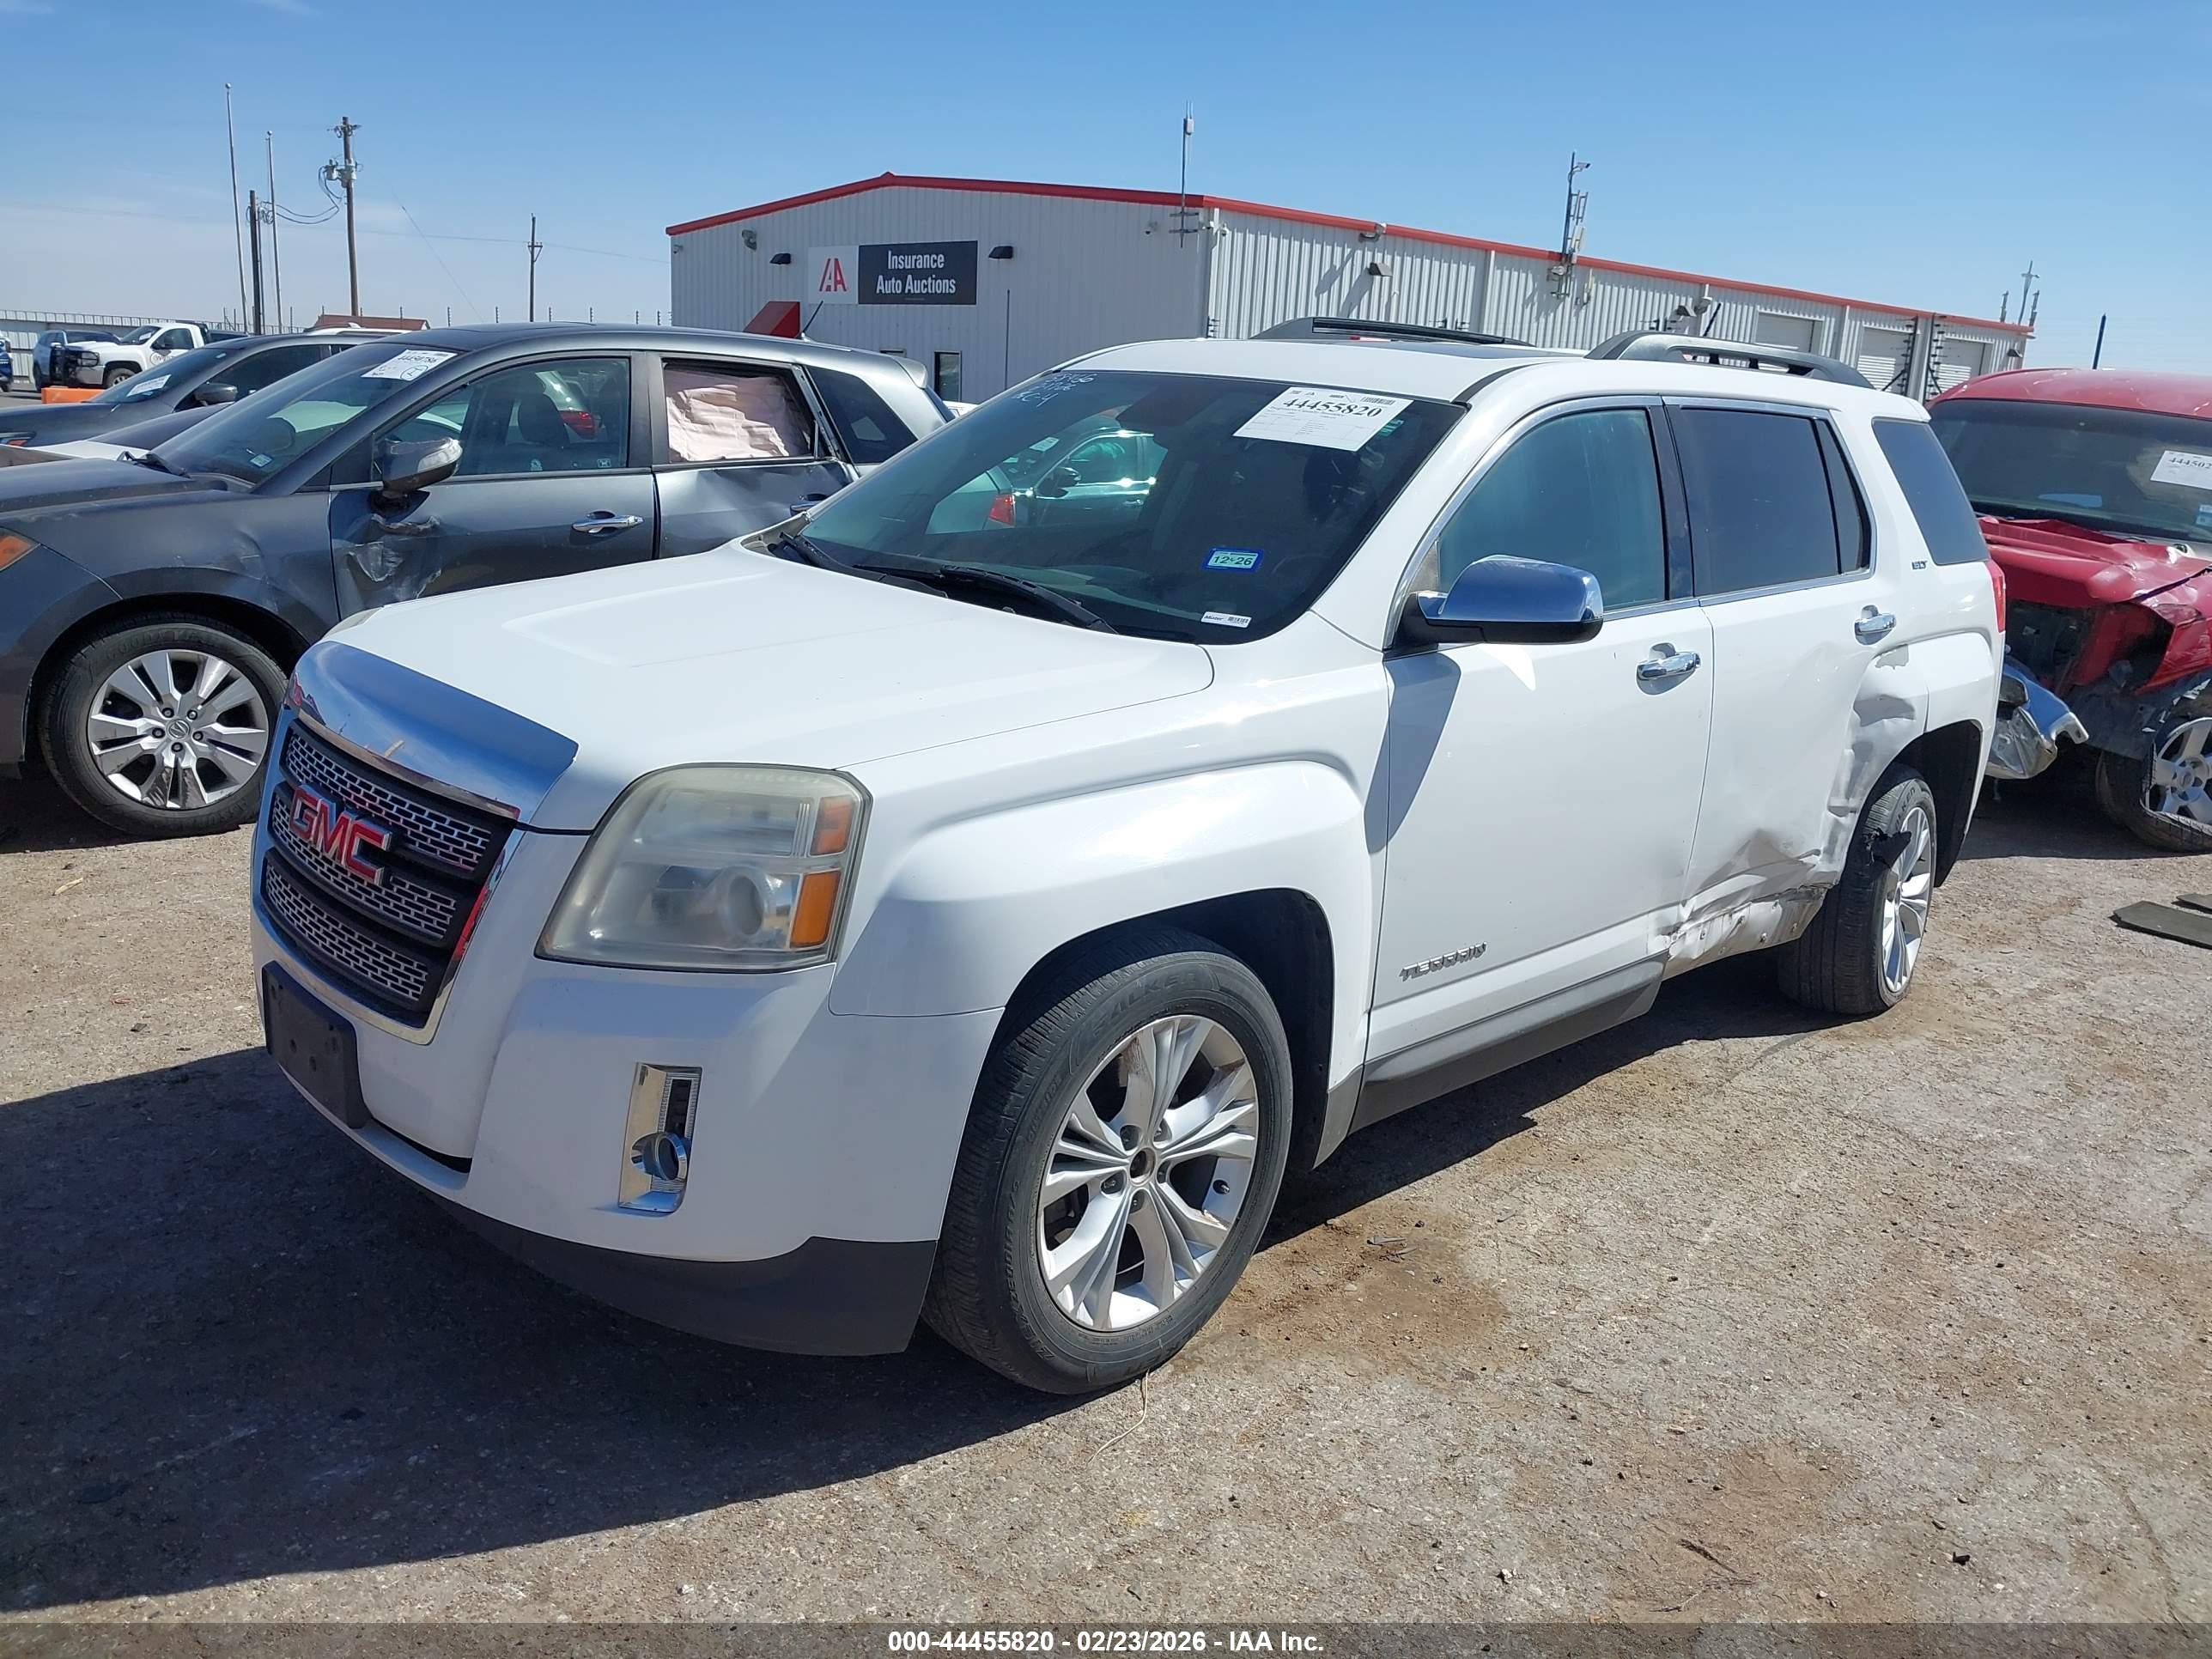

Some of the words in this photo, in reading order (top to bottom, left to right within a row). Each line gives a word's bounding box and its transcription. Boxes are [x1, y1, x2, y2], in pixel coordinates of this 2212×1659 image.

[887, 250, 945, 270] Insurance
[876, 274, 902, 294] Auto
[904, 273, 957, 294] Auctions
[1283, 398, 1382, 417] 44455820
[289, 785, 392, 886] GMC
